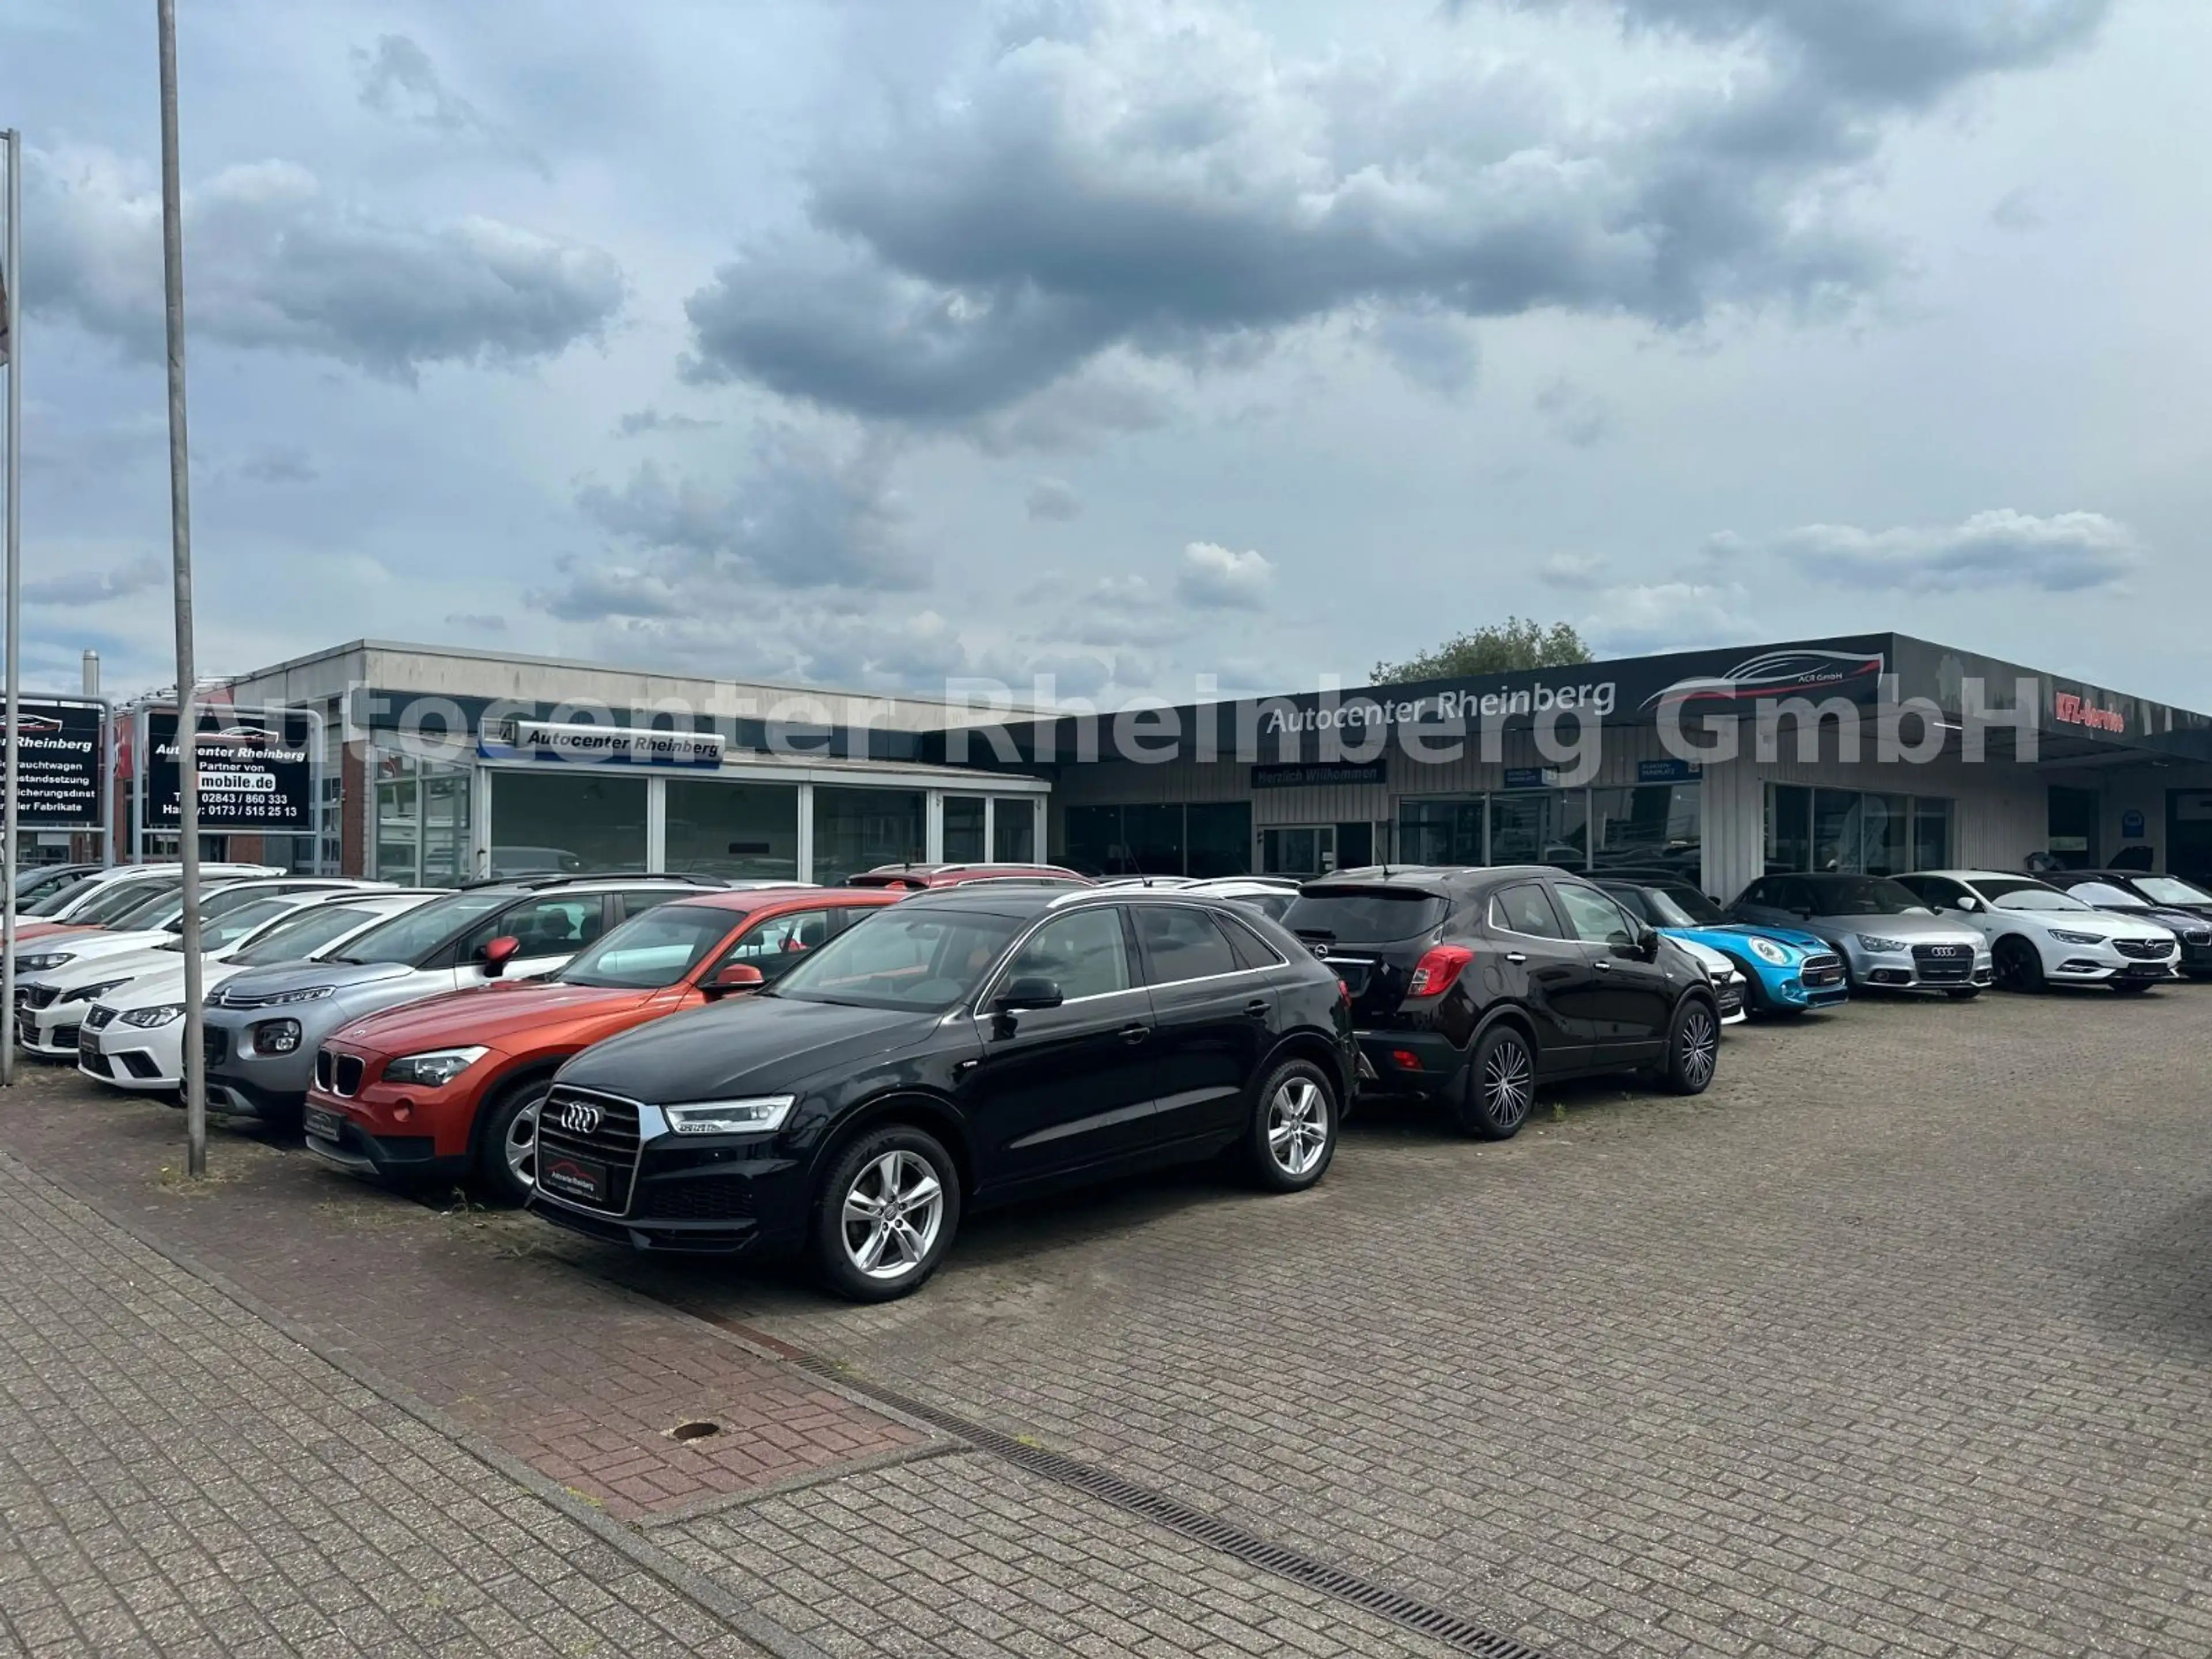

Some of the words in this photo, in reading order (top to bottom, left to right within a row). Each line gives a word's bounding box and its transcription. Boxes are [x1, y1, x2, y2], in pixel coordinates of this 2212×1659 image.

[1266, 698, 1426, 734] Autocenter
[1438, 681, 1616, 721] Rheinberg
[17, 737, 92, 752] Rheinberg
[527, 729, 630, 751] Autocenter
[634, 736, 719, 758] Rheinberg
[237, 747, 306, 762] Rheinberg
[199, 762, 241, 772] Partner
[245, 764, 265, 772] von
[1305, 767, 1377, 783] Willkommen
[202, 776, 273, 789] mobile.de
[202, 793, 236, 803] 02843
[237, 793, 242, 802] /
[245, 794, 265, 803] 860
[268, 794, 287, 804] 333
[34, 801, 82, 812] Fabrikate
[209, 805, 236, 816] 0173
[237, 805, 242, 816] /
[245, 806, 265, 816] 515
[268, 806, 281, 816] 25
[285, 807, 297, 817] 13
